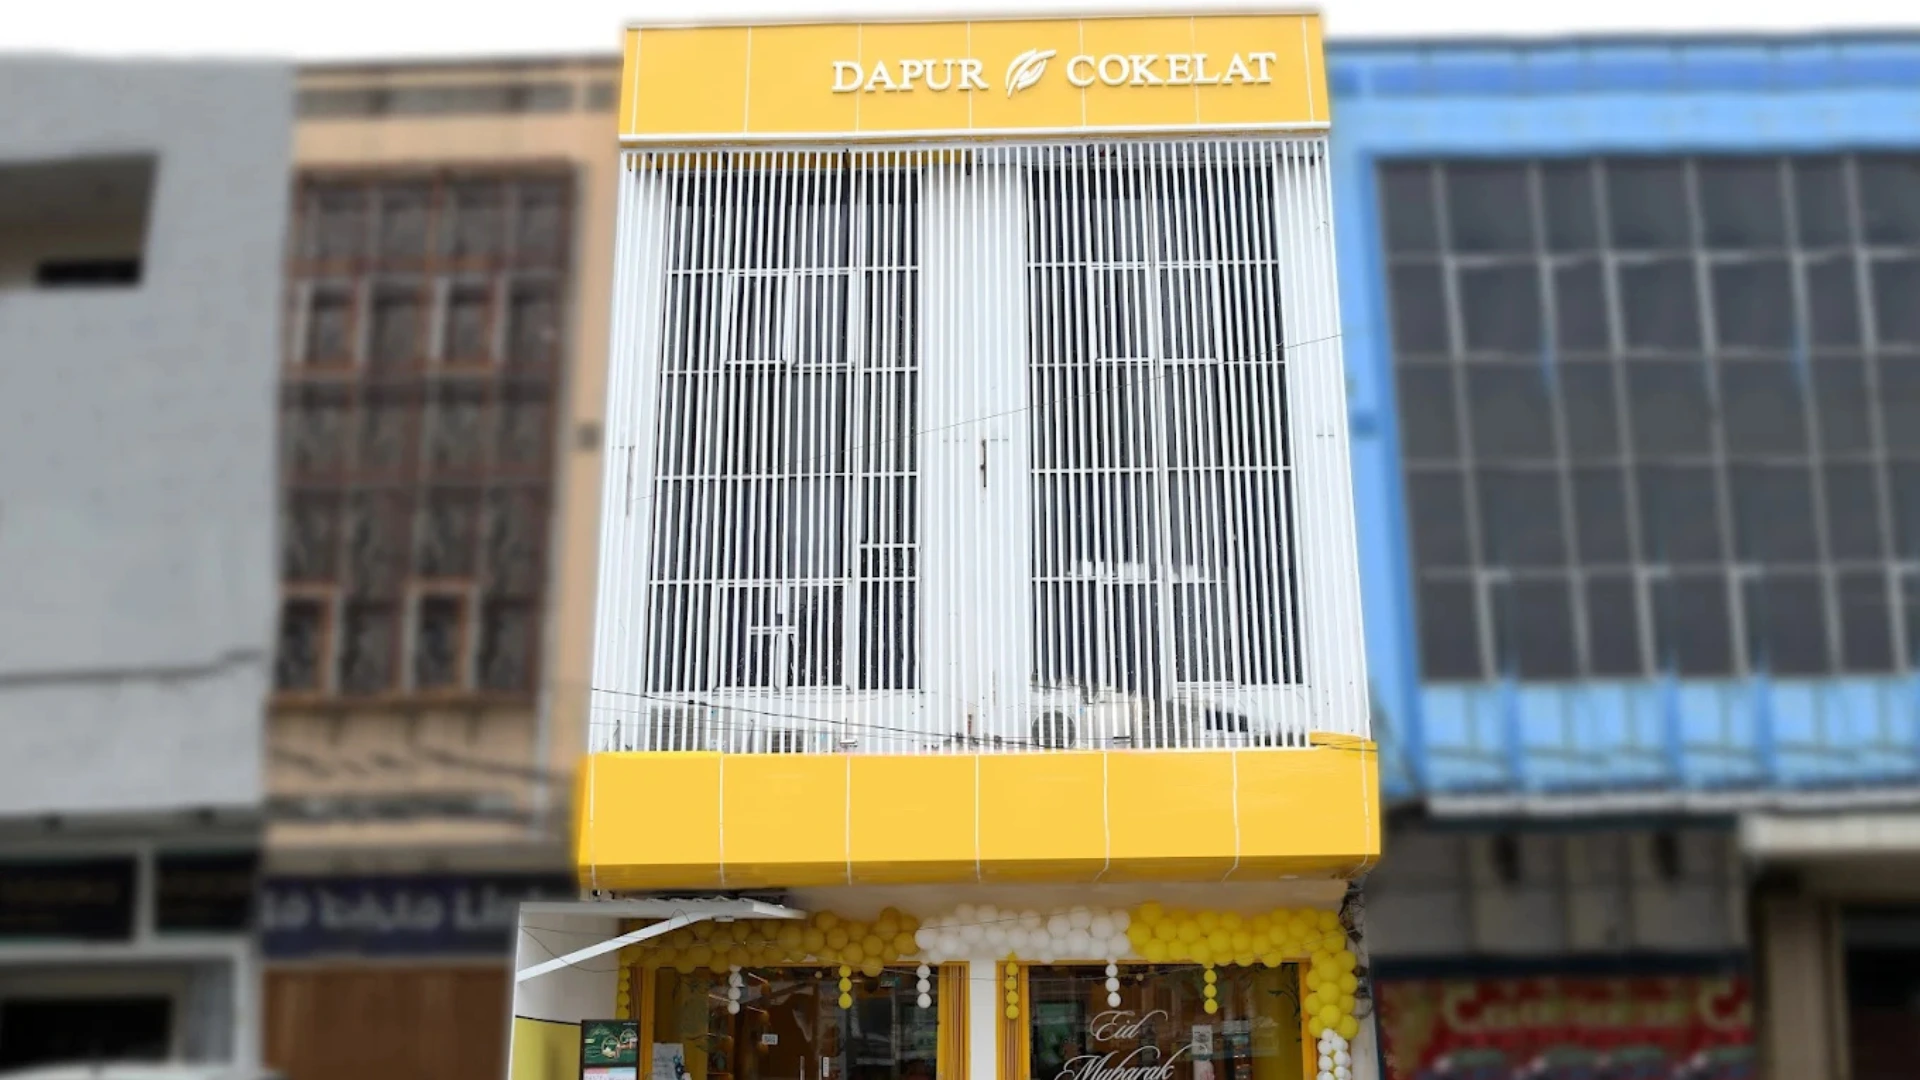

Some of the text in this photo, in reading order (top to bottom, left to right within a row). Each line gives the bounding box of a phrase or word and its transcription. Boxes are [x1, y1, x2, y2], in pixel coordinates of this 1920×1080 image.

[831, 52, 1277, 93] DAPUR COKELAT
[1089, 1009, 1169, 1042] Eid
[1054, 1045, 1208, 1080] Mubarak
